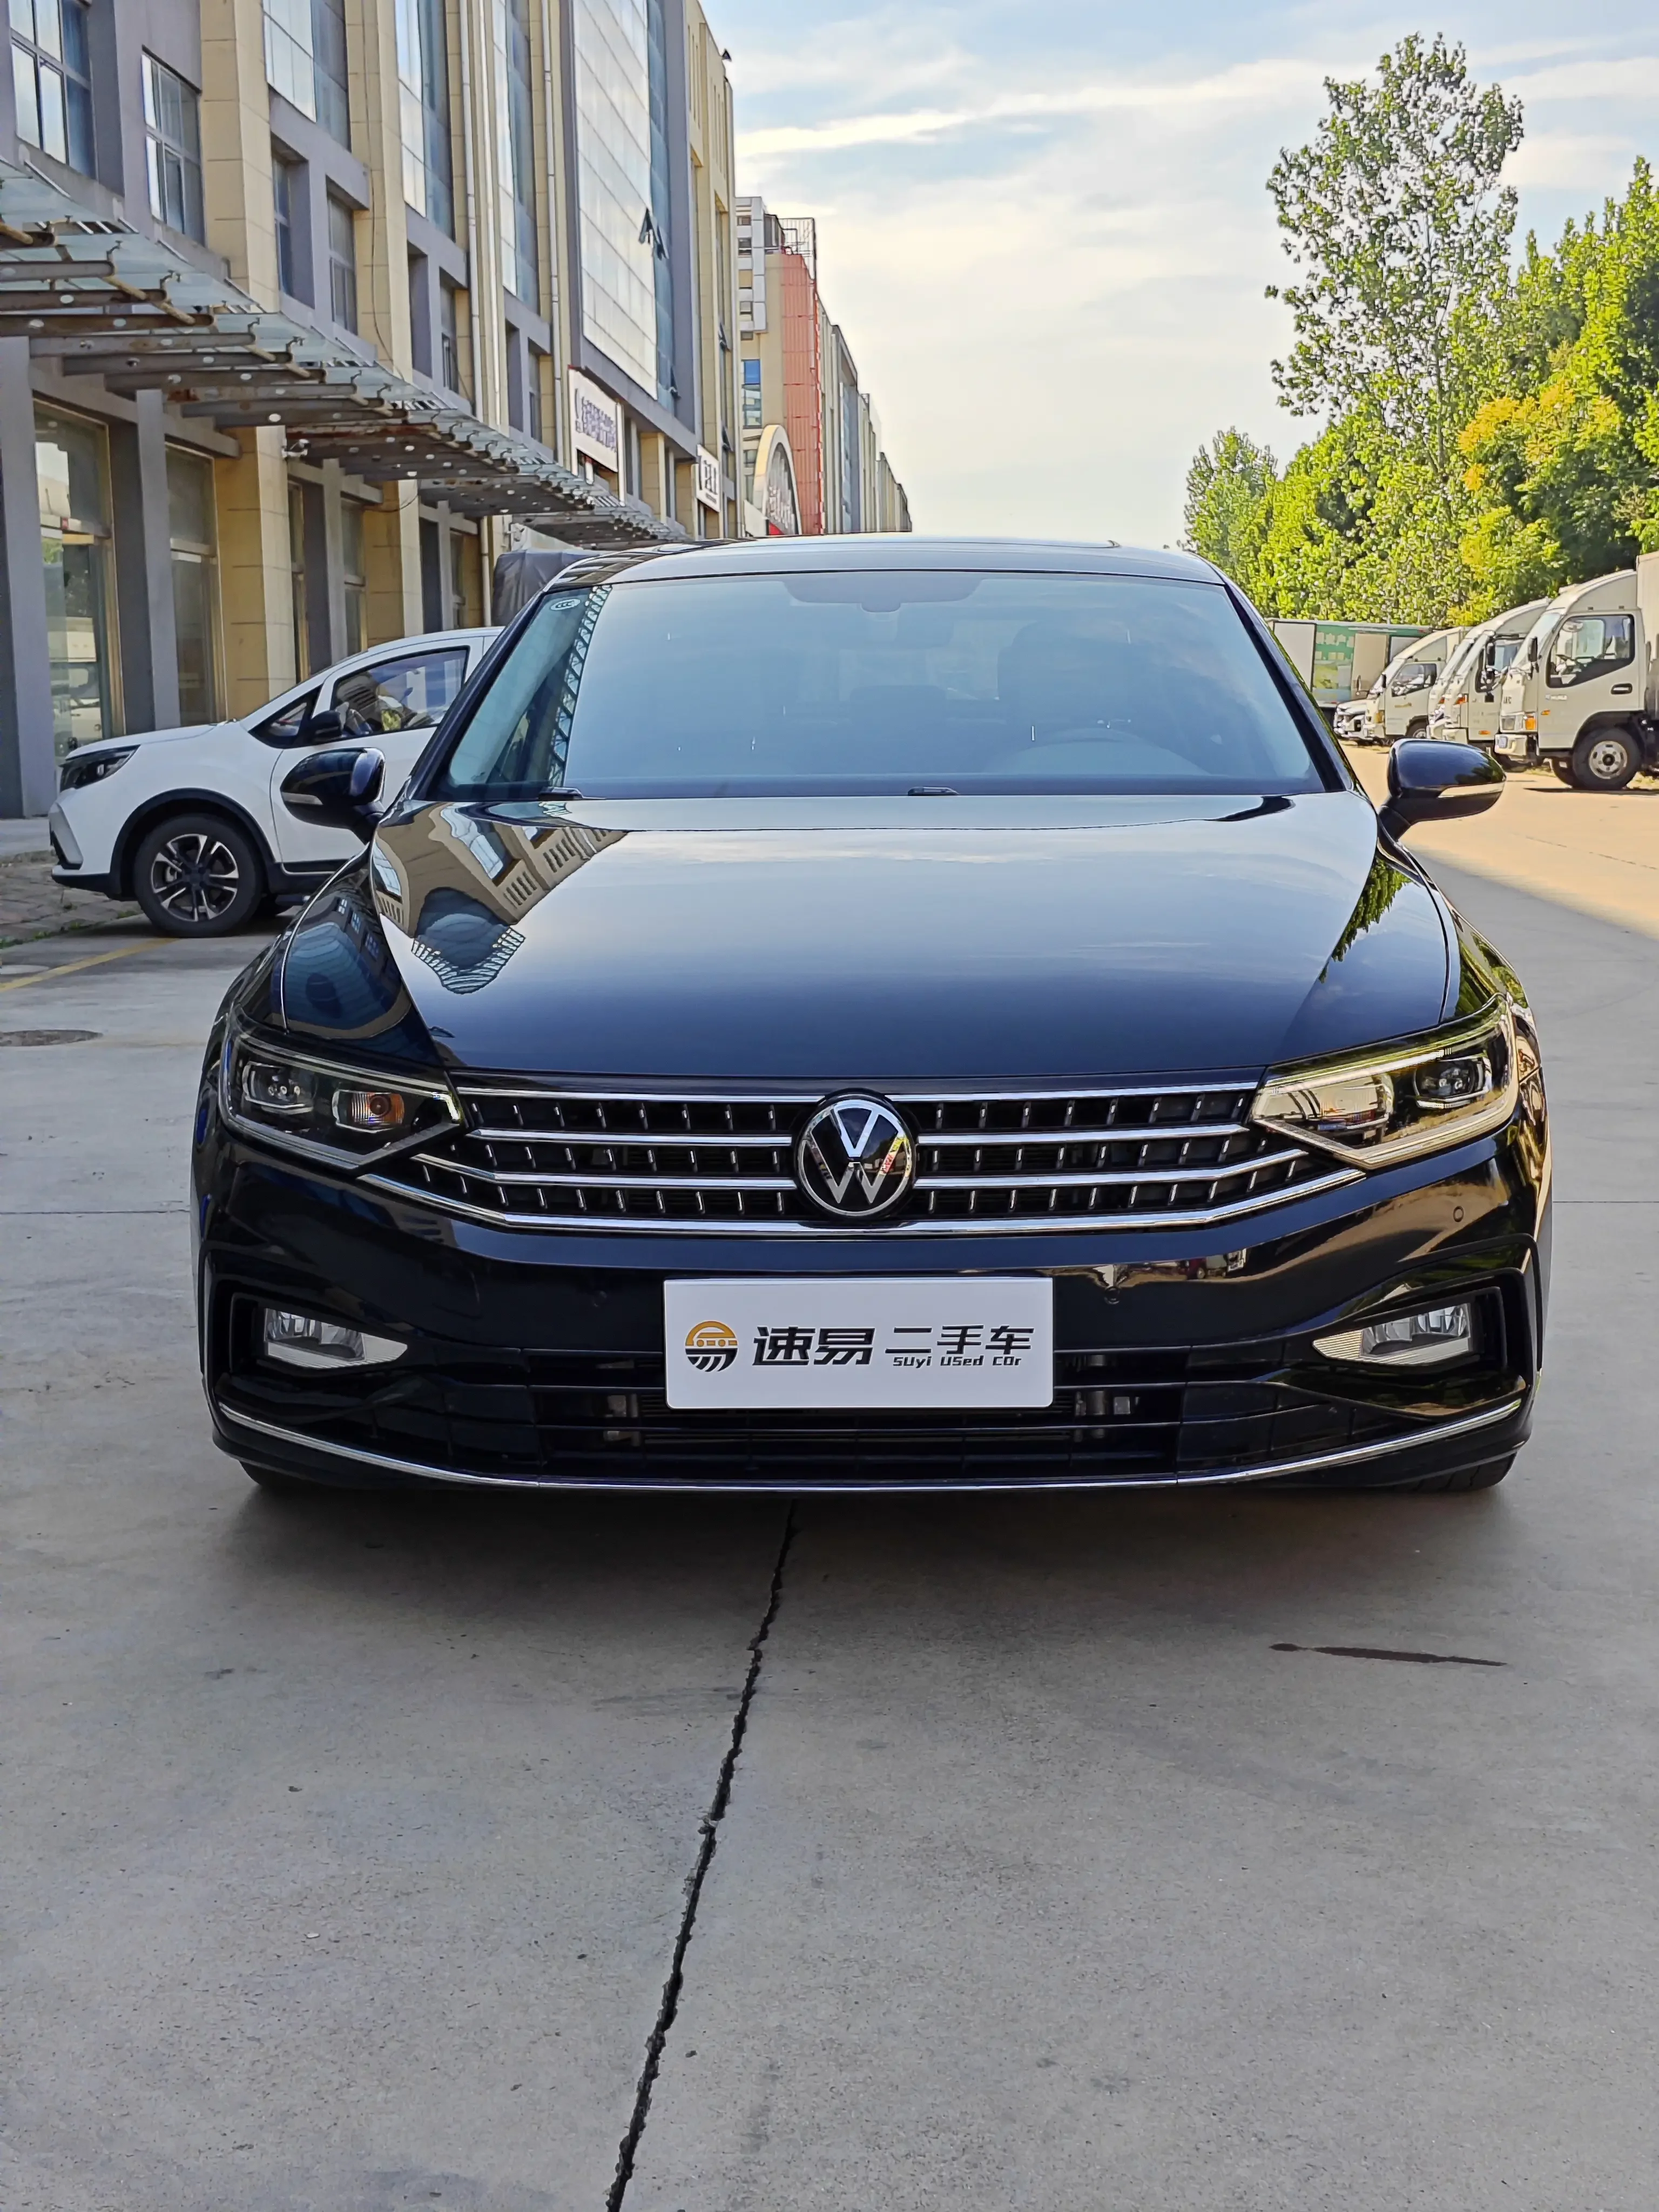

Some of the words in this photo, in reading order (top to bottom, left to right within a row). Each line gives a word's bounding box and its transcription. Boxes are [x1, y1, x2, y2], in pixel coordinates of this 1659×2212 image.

[752, 1325, 1034, 1365] 速易二手车
